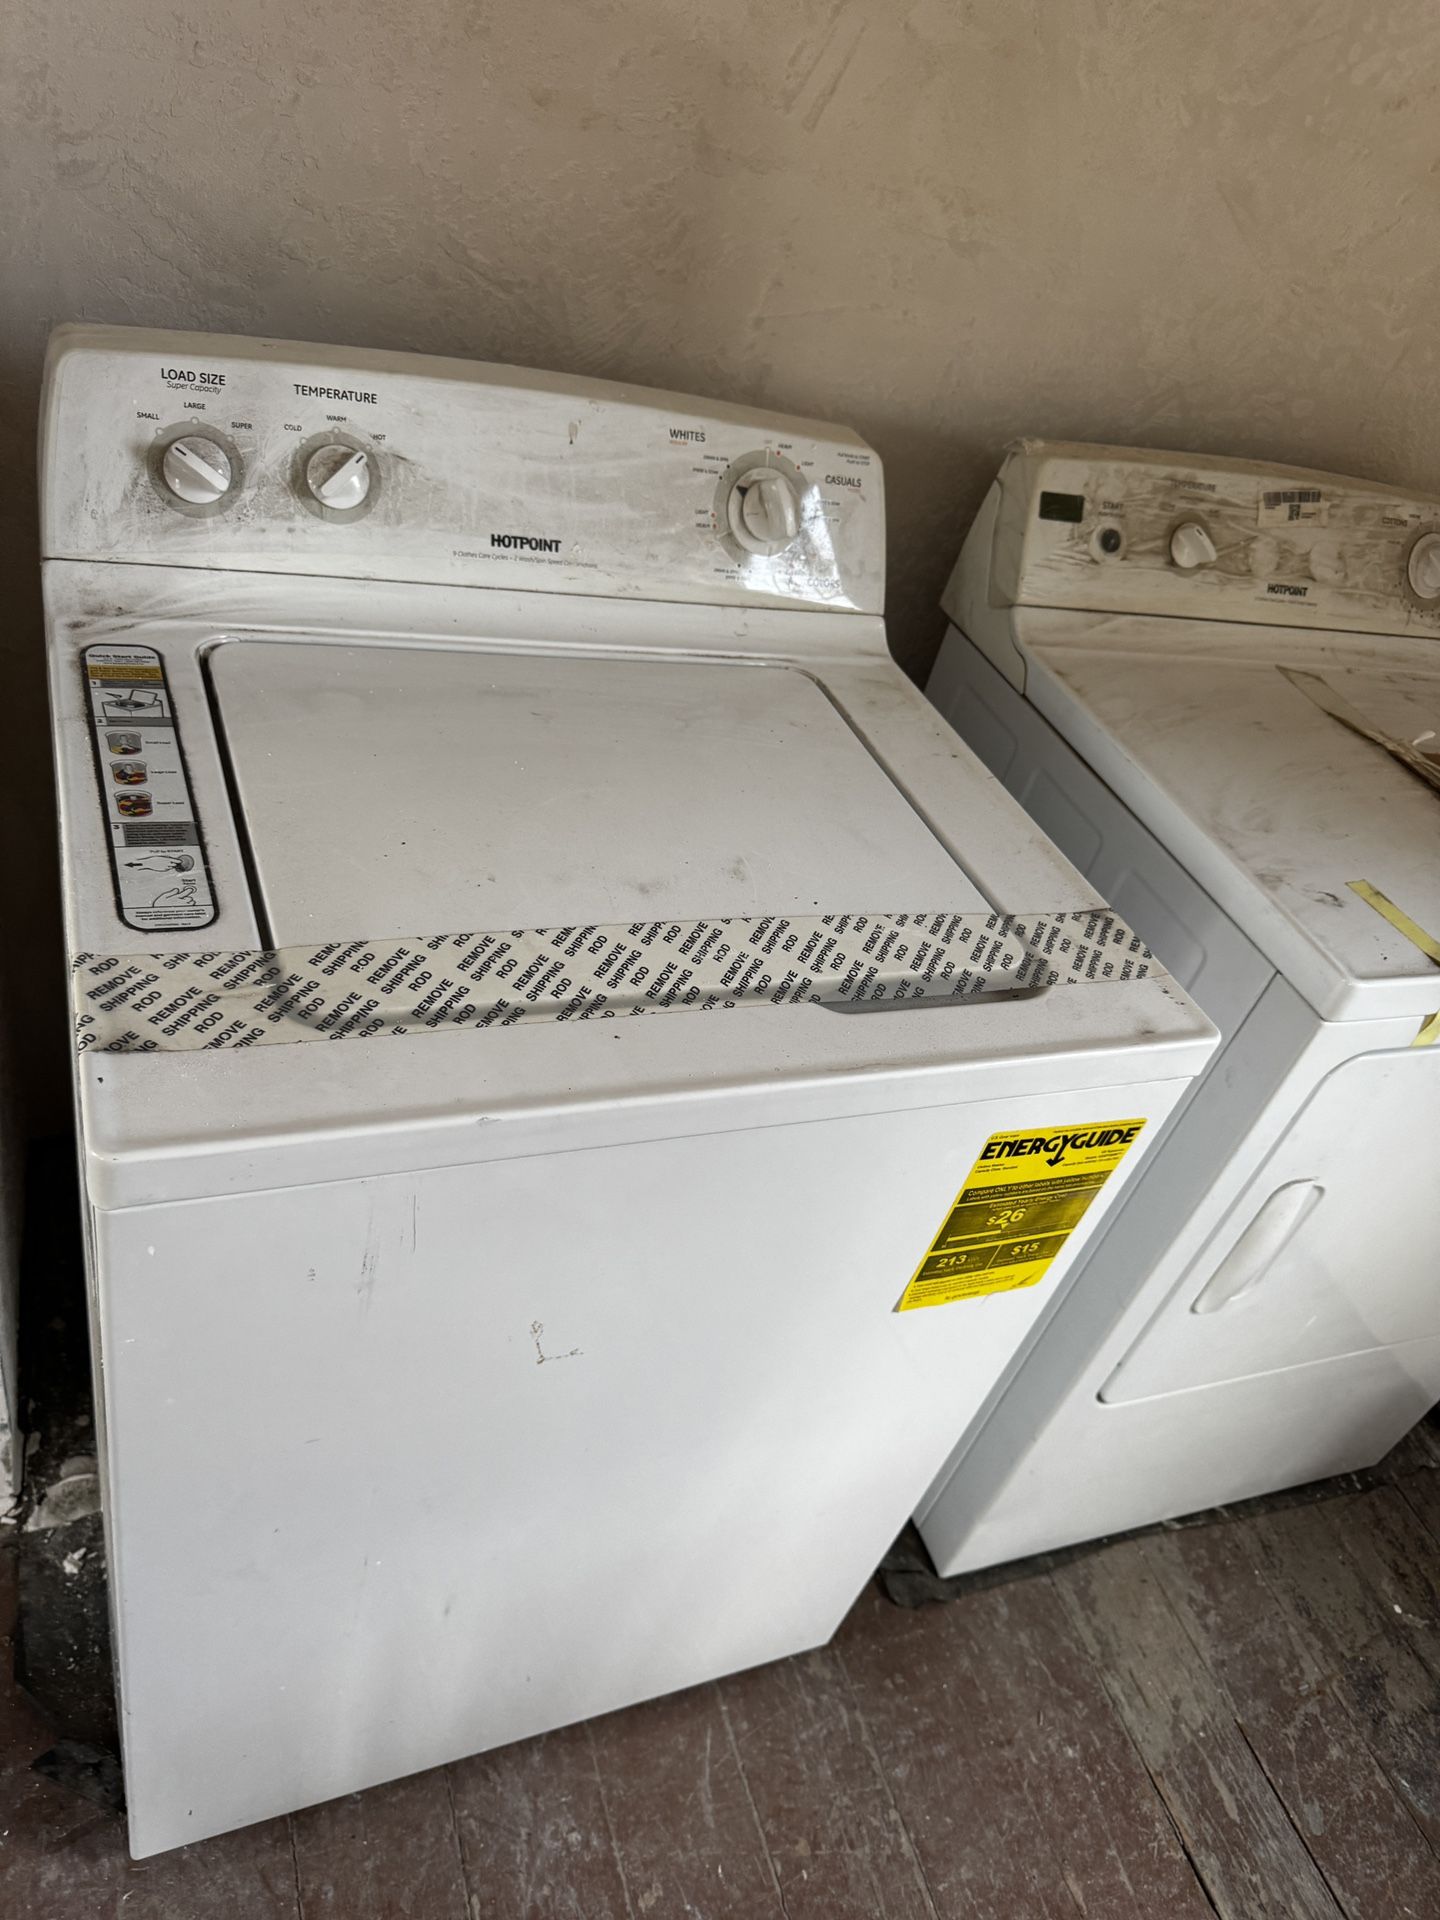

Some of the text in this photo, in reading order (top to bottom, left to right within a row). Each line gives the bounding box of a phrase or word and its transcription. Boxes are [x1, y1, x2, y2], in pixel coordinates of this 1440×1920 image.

[161, 368, 226, 386] LOAD SIZE
[166, 381, 222, 395] Super Capacity
[183, 402, 206, 410] LARGE
[293, 384, 378, 404] TEMPERATURE
[136, 411, 160, 420] SMALL
[231, 421, 253, 430] SUPER
[283, 423, 303, 432] COLD
[326, 415, 347, 423] WARM
[669, 428, 706, 443] WHITES
[825, 474, 862, 488] CASUALS
[457, 551, 478, 559] Clothes
[490, 533, 562, 553] HOTPOINT
[1266, 583, 1309, 597] HOTPOINT
[662, 925, 682, 943] ROD
[761, 919, 790, 955] SHIPPING
[853, 916, 868, 933] ROD
[941, 915, 963, 944] SHIPPING
[959, 927, 973, 943] ROD
[1014, 924, 1026, 938] ROD
[1030, 921, 1047, 947] REMOVE
[1084, 913, 1101, 939] REMOVE
[1097, 916, 1114, 947] SHIPPING
[1113, 929, 1125, 945] ROD
[587, 935, 608, 954] ROD
[678, 921, 709, 955] REMOVE
[691, 928, 723, 965] SHIPPING
[781, 934, 799, 952] ROD
[797, 931, 823, 964] REMOVE
[862, 923, 884, 954] REMOVE
[875, 930, 900, 963] SHIPPING
[970, 934, 990, 963] REMOVE
[1043, 926, 1061, 955] SHIPPING
[1059, 939, 1072, 953] ROD
[350, 952, 375, 973] ROD
[456, 935, 496, 972] REMOVE
[470, 942, 512, 982] SHIPPING
[593, 942, 628, 979] REMOVE
[712, 943, 731, 963] ROD
[810, 937, 838, 973] SHIPPING
[830, 952, 846, 971] ROD
[894, 944, 909, 961] ROD
[909, 941, 932, 972] REMOVE
[921, 947, 946, 983] SHIPPING
[982, 940, 1004, 972] SHIPPING
[1000, 953, 1014, 970] ROD
[1072, 944, 1089, 972] REMOVE
[1085, 950, 1103, 980] SHIPPING
[89, 957, 119, 975] ROD
[223, 951, 277, 990] SHIPPING
[253, 967, 281, 986] ROD
[367, 947, 410, 985] REMOVE
[381, 954, 427, 994] SHIPPING
[495, 958, 518, 979] ROD
[512, 954, 550, 991] REMOVE
[606, 950, 643, 989] SHIPPING
[629, 966, 650, 986] ROD
[719, 951, 750, 987] REMOVE
[732, 958, 764, 997] SHIPPING
[838, 959, 864, 996] REMOVE
[940, 961, 955, 981] ROD
[1015, 951, 1034, 981] REMOVE
[1029, 958, 1048, 989] SHIPPING
[1046, 970, 1059, 985] ROD
[1102, 962, 1114, 977] ROD
[86, 966, 142, 1000] REMOVE
[99, 973, 160, 1012] SHIPPING
[253, 973, 303, 1012] REMOVE
[408, 970, 433, 992] ROD
[525, 961, 566, 1002] SHIPPING
[551, 977, 573, 999] ROD
[645, 961, 678, 999] REMOVE
[659, 969, 694, 1008] SHIPPING
[754, 974, 772, 995] ROD
[771, 969, 798, 1005] REMOVE
[851, 967, 879, 1001] SHIPPING
[871, 983, 887, 1001] ROD
[132, 991, 162, 1012] ROD
[148, 986, 203, 1025] REMOVE
[268, 980, 321, 1023] SHIPPING
[297, 997, 325, 1020] ROD
[412, 978, 454, 1018] REMOVE
[425, 986, 471, 1028] SHIPPING
[556, 985, 592, 1022] REMOVE
[682, 985, 701, 1006] ROD
[161, 993, 221, 1036] SHIPPING
[194, 1011, 224, 1034] ROD
[315, 992, 363, 1032] REMOVE
[329, 999, 381, 1041] SHIPPING
[452, 1003, 476, 1025] ROD
[358, 1018, 385, 1037] ROD
[979, 1126, 1142, 1167] ENERGYGUIDE
[986, 1208, 1027, 1226] $26
[935, 1254, 968, 1268] 213
[1010, 1241, 1041, 1256] $15
